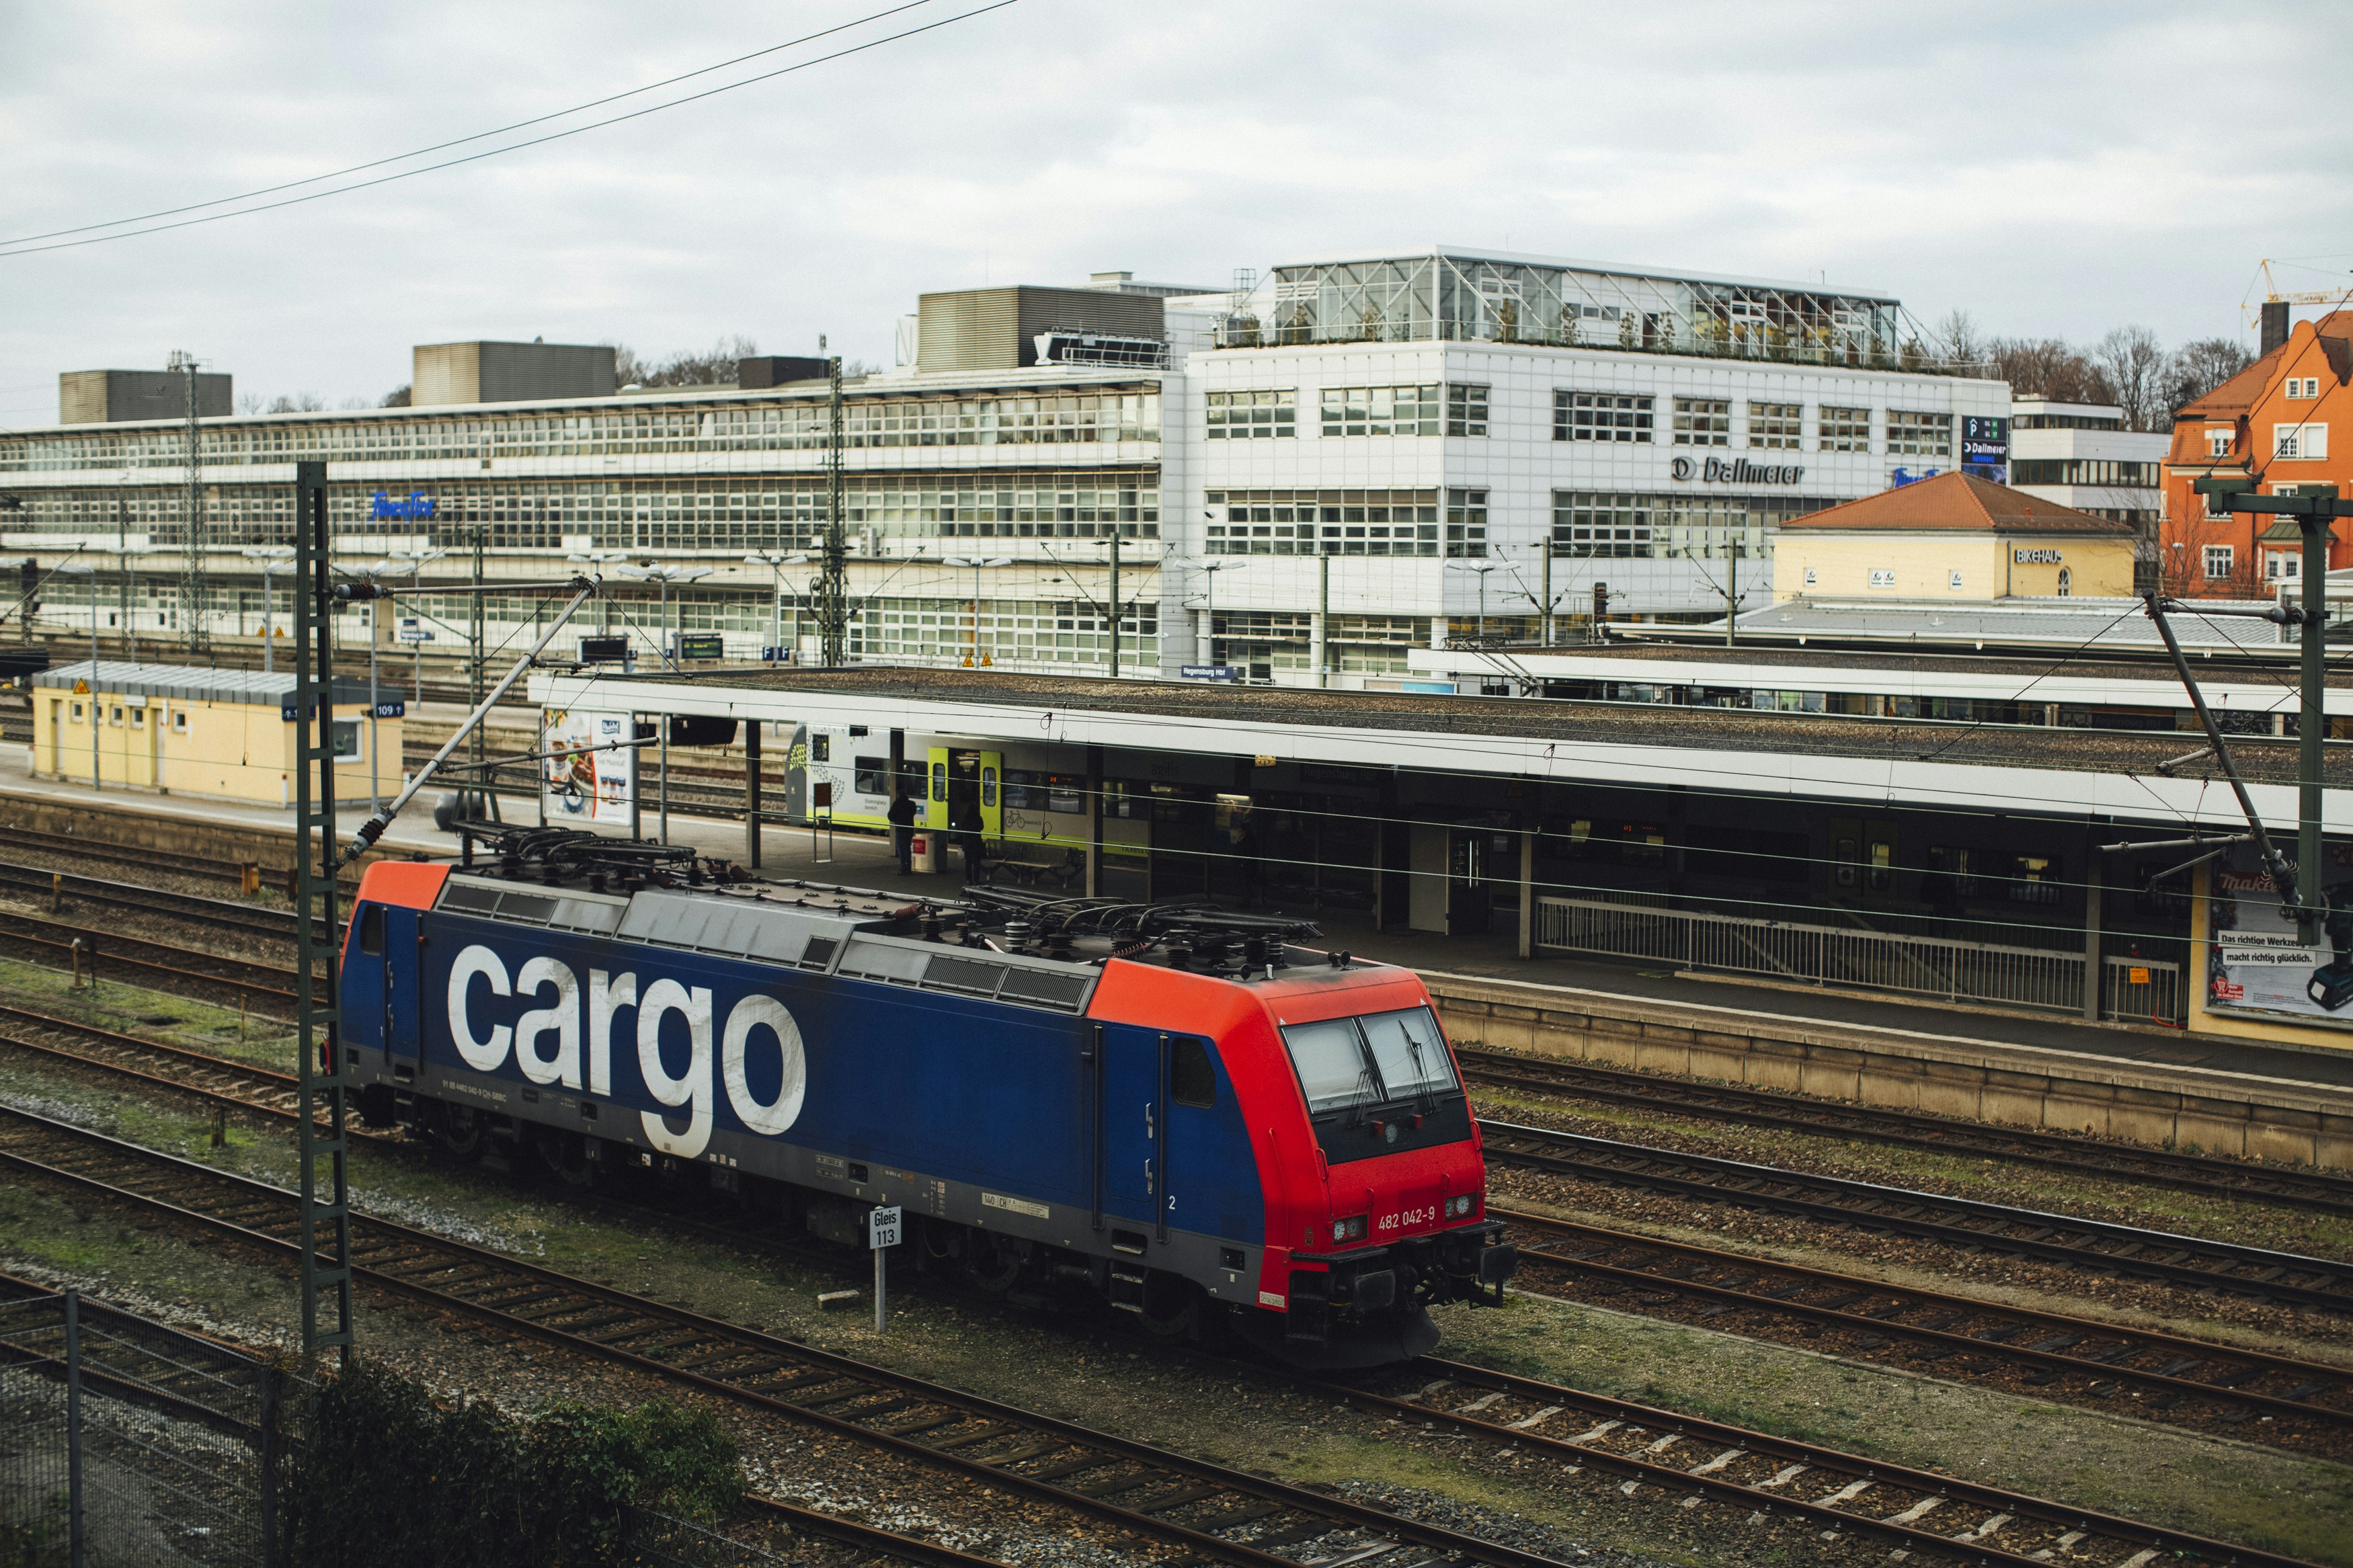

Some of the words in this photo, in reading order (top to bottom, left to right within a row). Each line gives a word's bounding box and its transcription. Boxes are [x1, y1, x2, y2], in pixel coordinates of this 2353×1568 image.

[1972, 442, 2006, 455] Dallmeier
[1704, 456, 1806, 484] Dallmeier
[2015, 549, 2063, 563] BIKEHAUS
[1183, 667, 1214, 677] Regensburg
[377, 706, 393, 716] 109
[2222, 935, 2236, 943] Das
[2238, 935, 2266, 946] richtige
[2227, 952, 2250, 961] macht
[2251, 953, 2274, 963] richtig
[2277, 953, 2313, 964] glücklich.
[448, 944, 806, 1159] cargo
[985, 1195, 994, 1205] 140
[999, 1198, 1007, 1208] CH
[1168, 1195, 1176, 1210] 2
[875, 1210, 897, 1227] Gleis
[1378, 1213, 1399, 1231] 482
[1403, 1206, 1435, 1226] 042-9
[877, 1229, 895, 1245] 113
